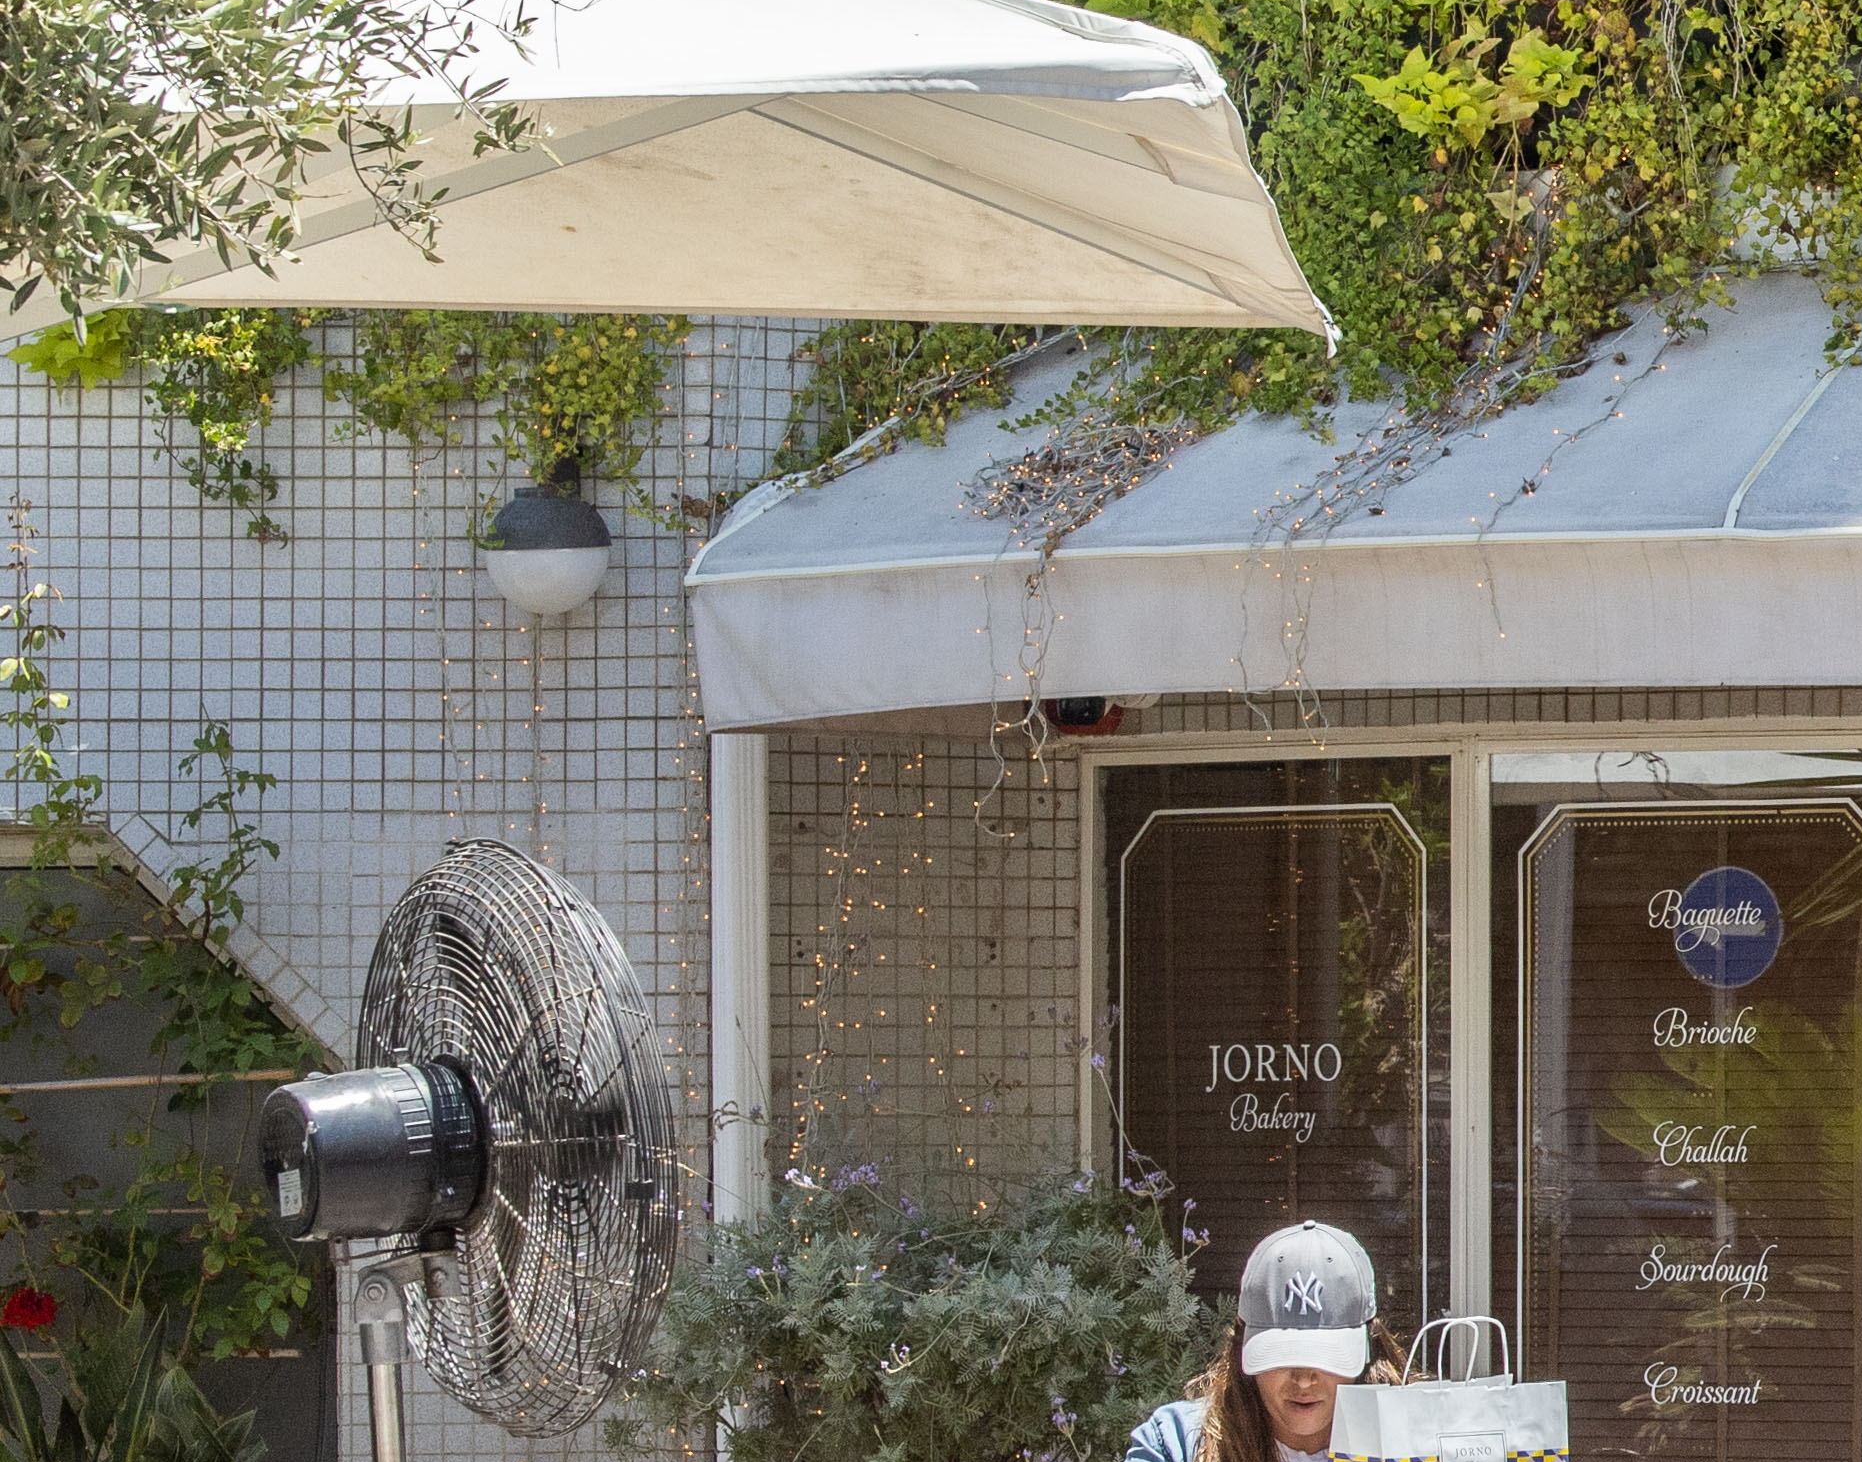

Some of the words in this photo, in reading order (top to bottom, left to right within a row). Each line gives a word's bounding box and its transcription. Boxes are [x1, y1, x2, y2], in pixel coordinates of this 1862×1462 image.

[1648, 889, 1762, 953] Baguette
[1653, 1006, 1757, 1048] Brioche
[1205, 1043, 1342, 1093] JORNO
[1230, 1092, 1316, 1143] Bakery
[1653, 1120, 1758, 1167] Challah
[1284, 1270, 1323, 1315] NY
[1635, 1243, 1779, 1303] Sourdough
[1643, 1361, 1762, 1405] Croissant
[1454, 1446, 1492, 1460] JORNO
